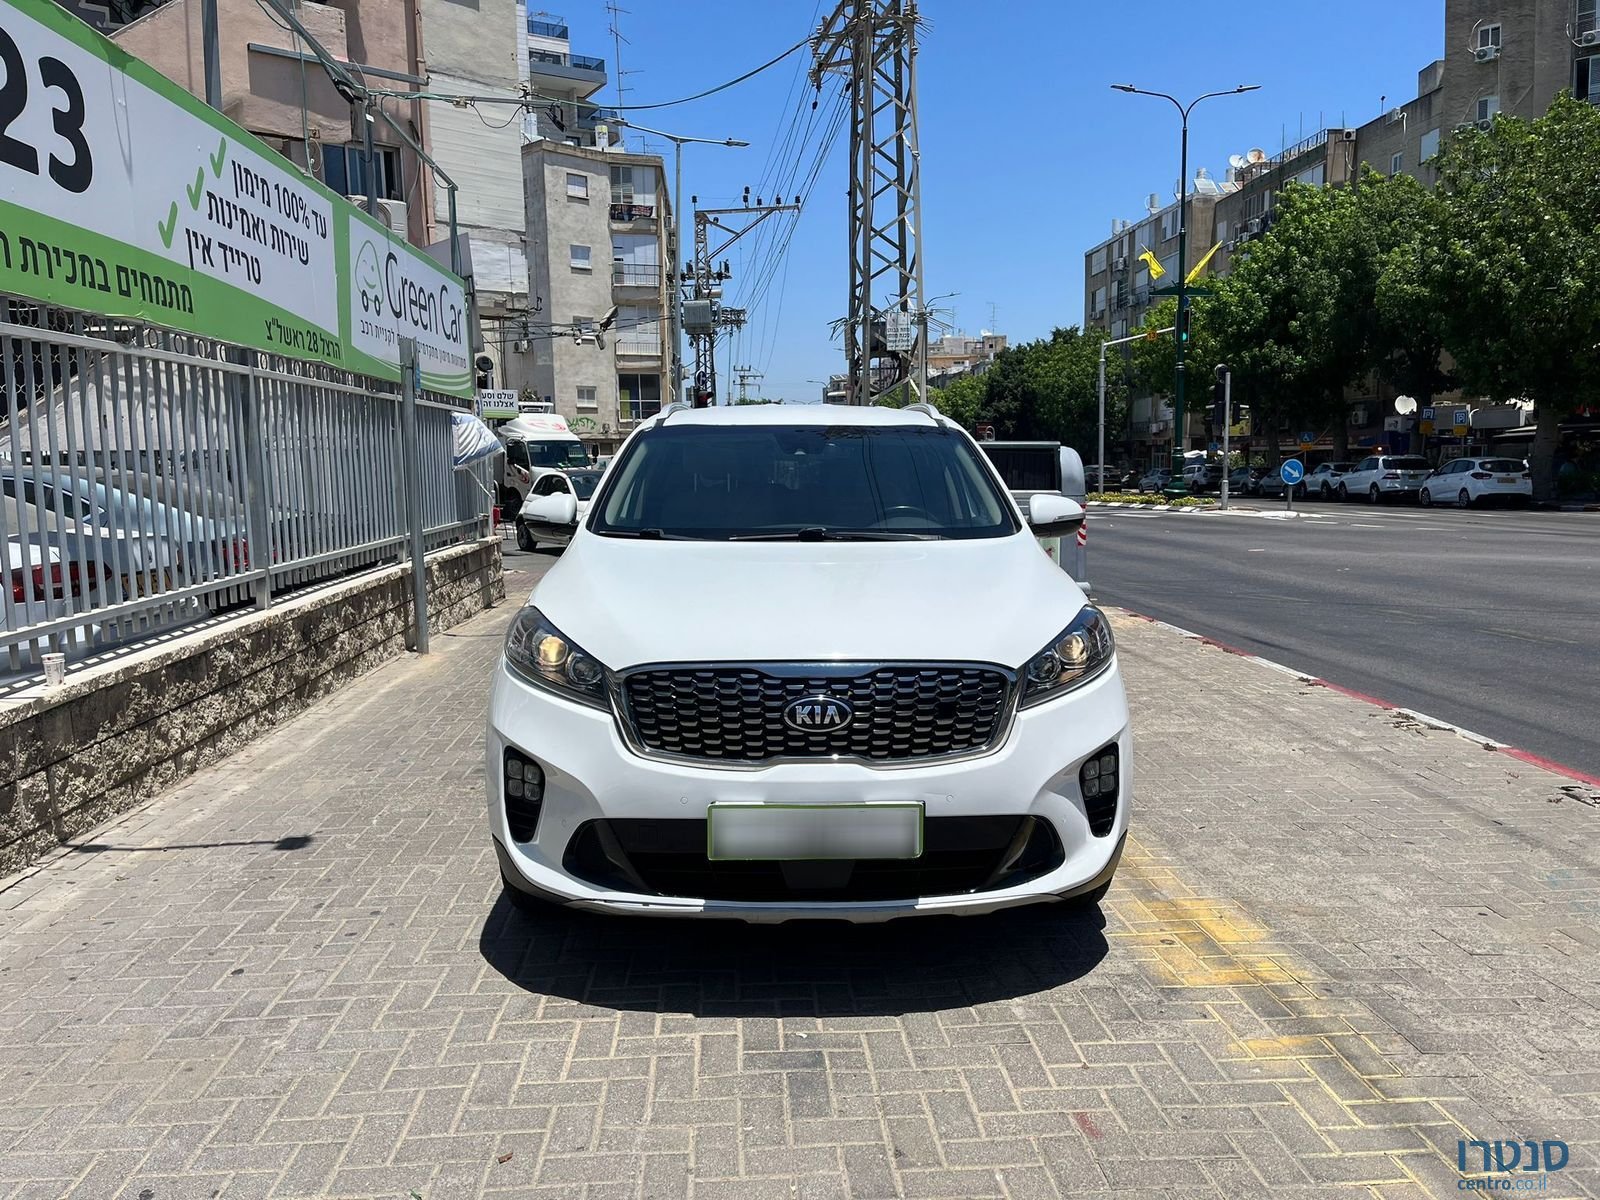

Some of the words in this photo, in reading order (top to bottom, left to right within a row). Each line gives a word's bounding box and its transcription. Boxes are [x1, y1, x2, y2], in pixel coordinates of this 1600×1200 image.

[231, 160, 271, 208] מימון
[206, 190, 267, 246] ואמינות
[274, 183, 311, 230] 100%
[312, 209, 328, 240] עד
[18, 235, 112, 293] במכירת
[185, 227, 215, 271] אין
[217, 241, 262, 285] טרייד
[270, 224, 309, 266] שירות
[115, 264, 194, 314] מתמחים
[385, 251, 439, 335] Green
[440, 284, 462, 345] Car
[306, 329, 318, 354] 28
[319, 333, 341, 361] הרצל
[360, 319, 374, 337] רכב
[795, 705, 841, 725] KIA
